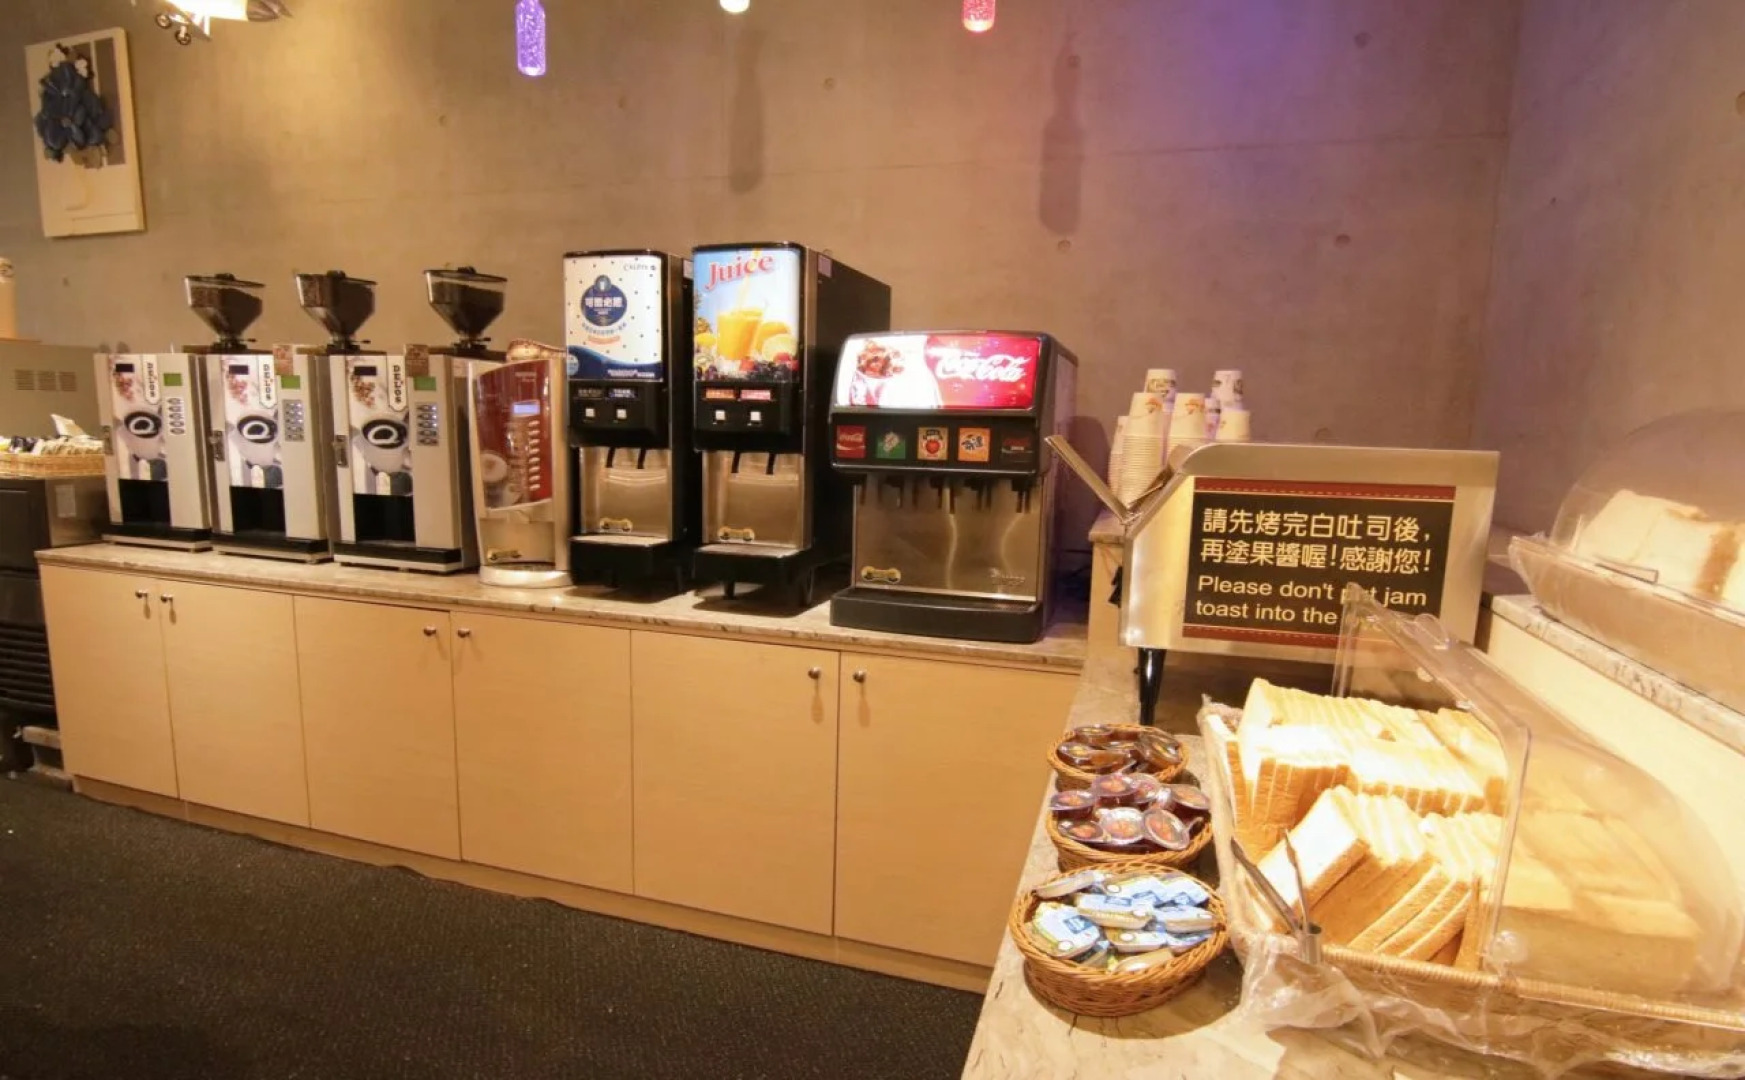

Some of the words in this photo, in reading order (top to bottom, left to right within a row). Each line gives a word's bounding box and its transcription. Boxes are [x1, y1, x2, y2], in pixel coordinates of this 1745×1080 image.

[703, 255, 774, 291] Juice
[1197, 575, 1273, 596] Please
[1279, 581, 1334, 600] don't
[1383, 587, 1427, 608] jam
[1196, 600, 1249, 619] toast
[1255, 604, 1297, 622] into
[1302, 608, 1338, 625] the
